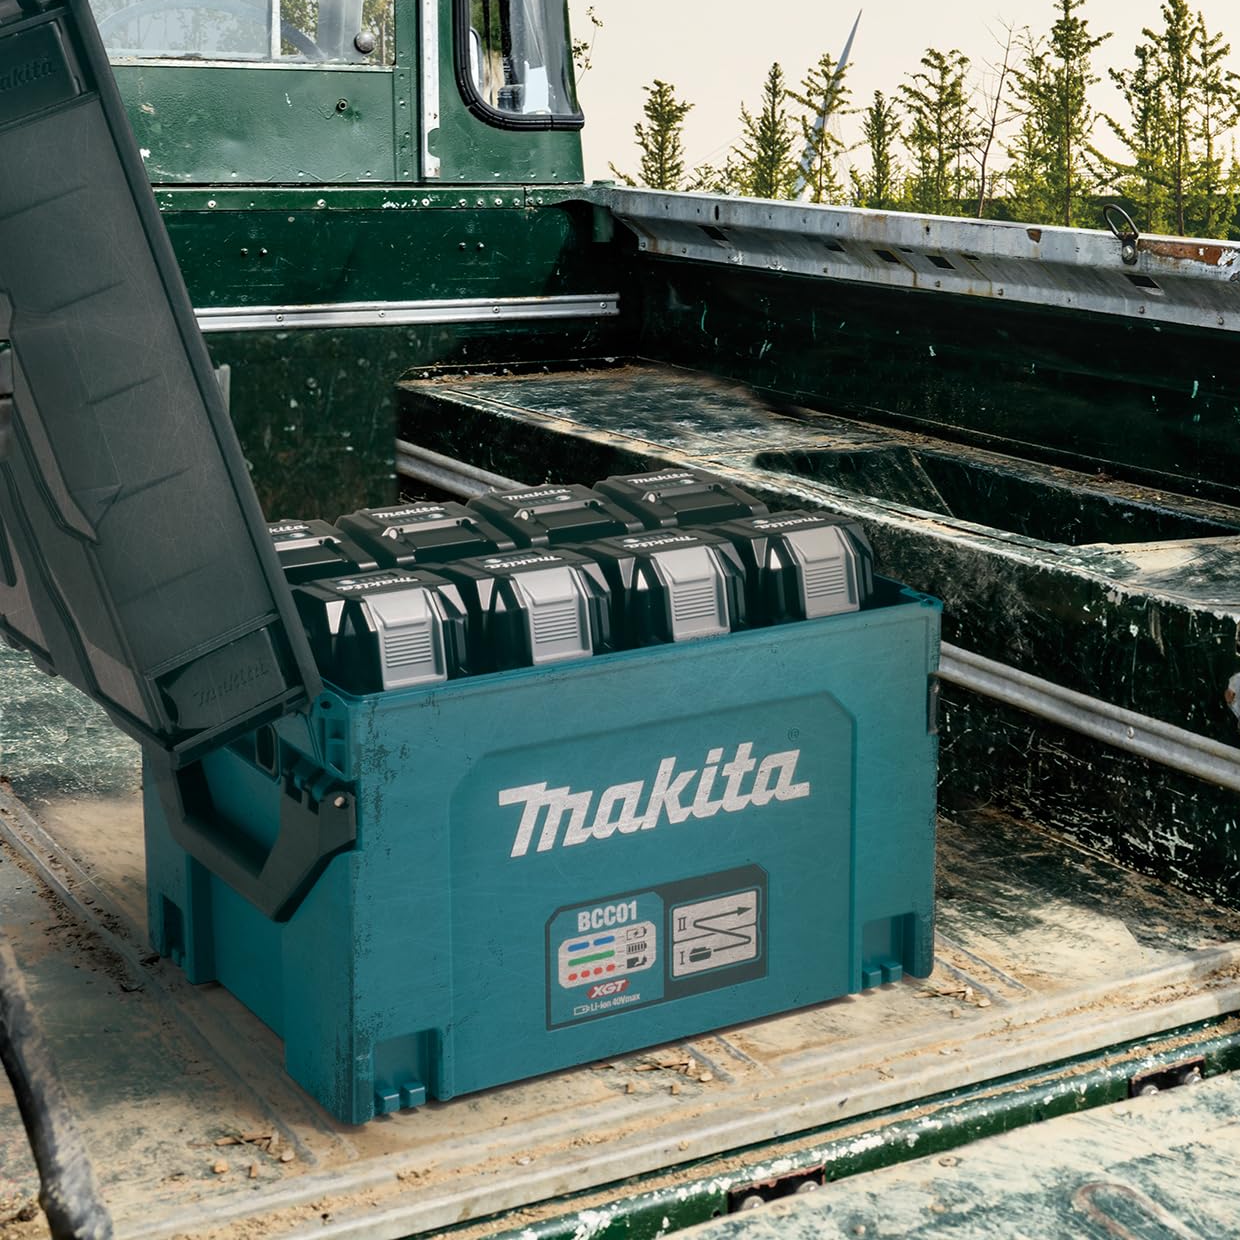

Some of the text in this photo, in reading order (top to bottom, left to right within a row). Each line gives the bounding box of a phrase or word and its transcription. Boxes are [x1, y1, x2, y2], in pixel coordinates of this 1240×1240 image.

[269, 523, 310, 533] kita
[577, 899, 638, 933] BCC01
[591, 979, 626, 999] XGT
